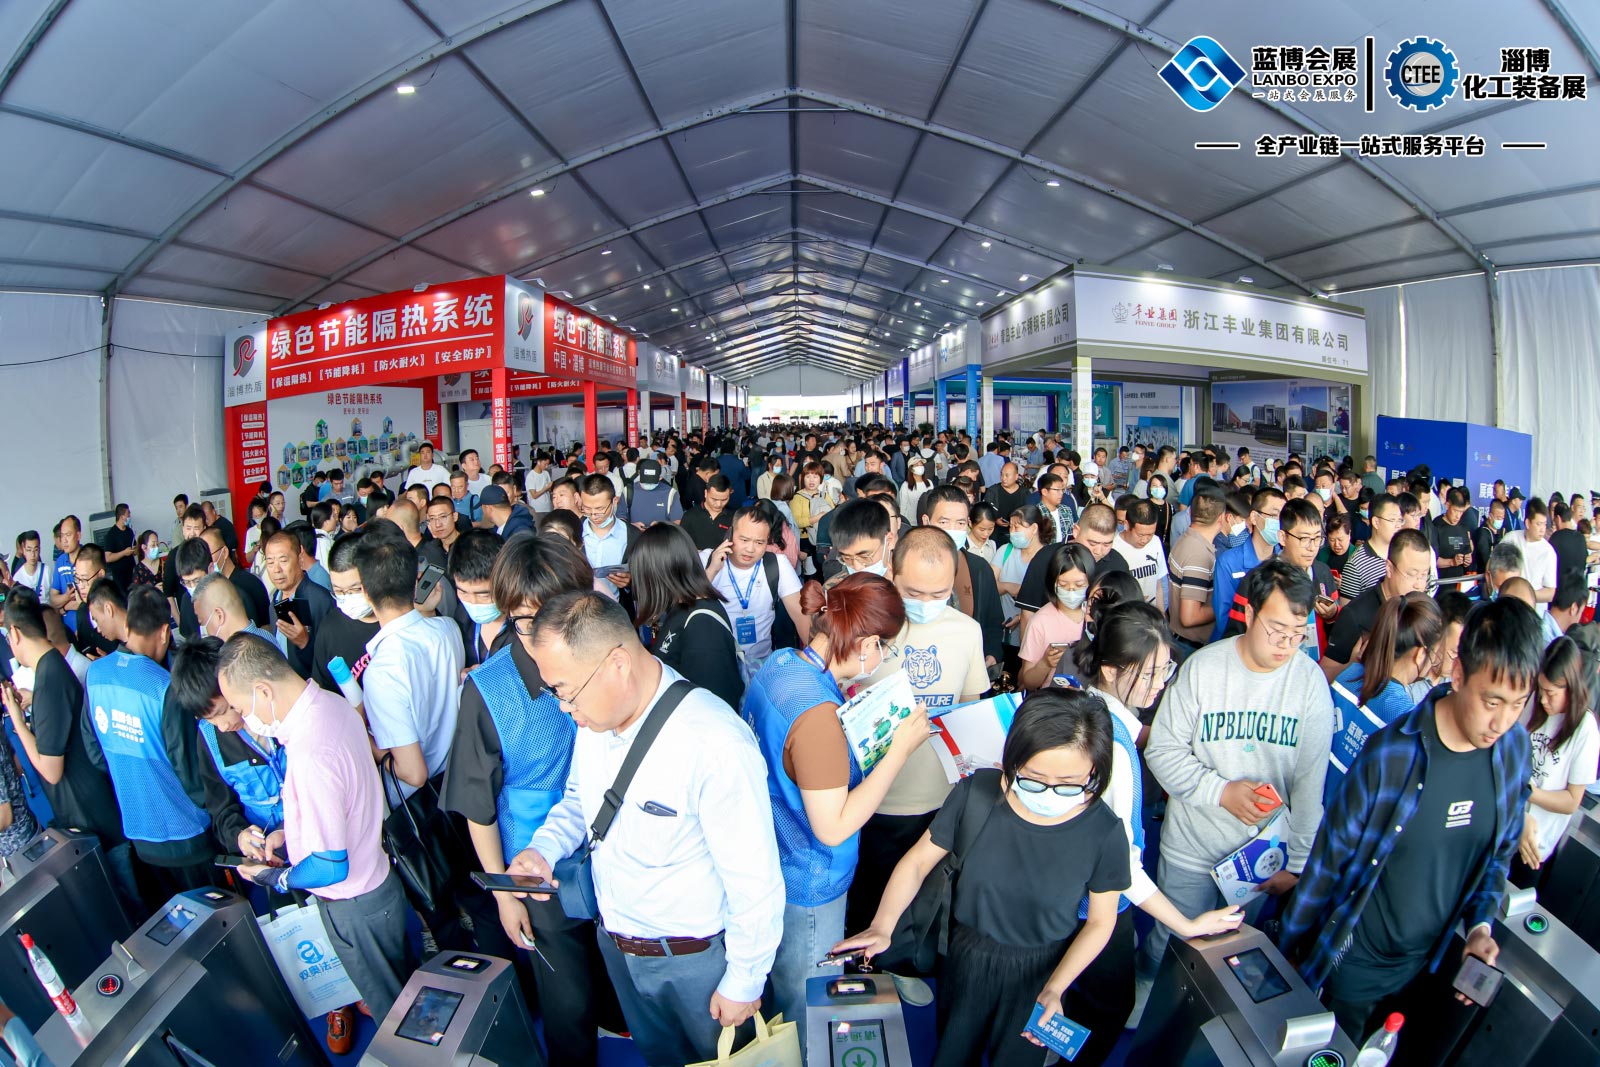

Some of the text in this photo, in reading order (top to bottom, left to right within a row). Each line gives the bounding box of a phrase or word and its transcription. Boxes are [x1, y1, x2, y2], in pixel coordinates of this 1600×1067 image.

[271, 294, 493, 360] 绿色节能隔热系统
[553, 305, 627, 361] 绿色节能隔热系统
[1183, 309, 1349, 351] 浙江丰业集团有限公司
[228, 380, 262, 398] 淄博热盾
[327, 392, 382, 406] 绿色节能隔热系统
[1200, 711, 1300, 748] NPBLUGLKL
